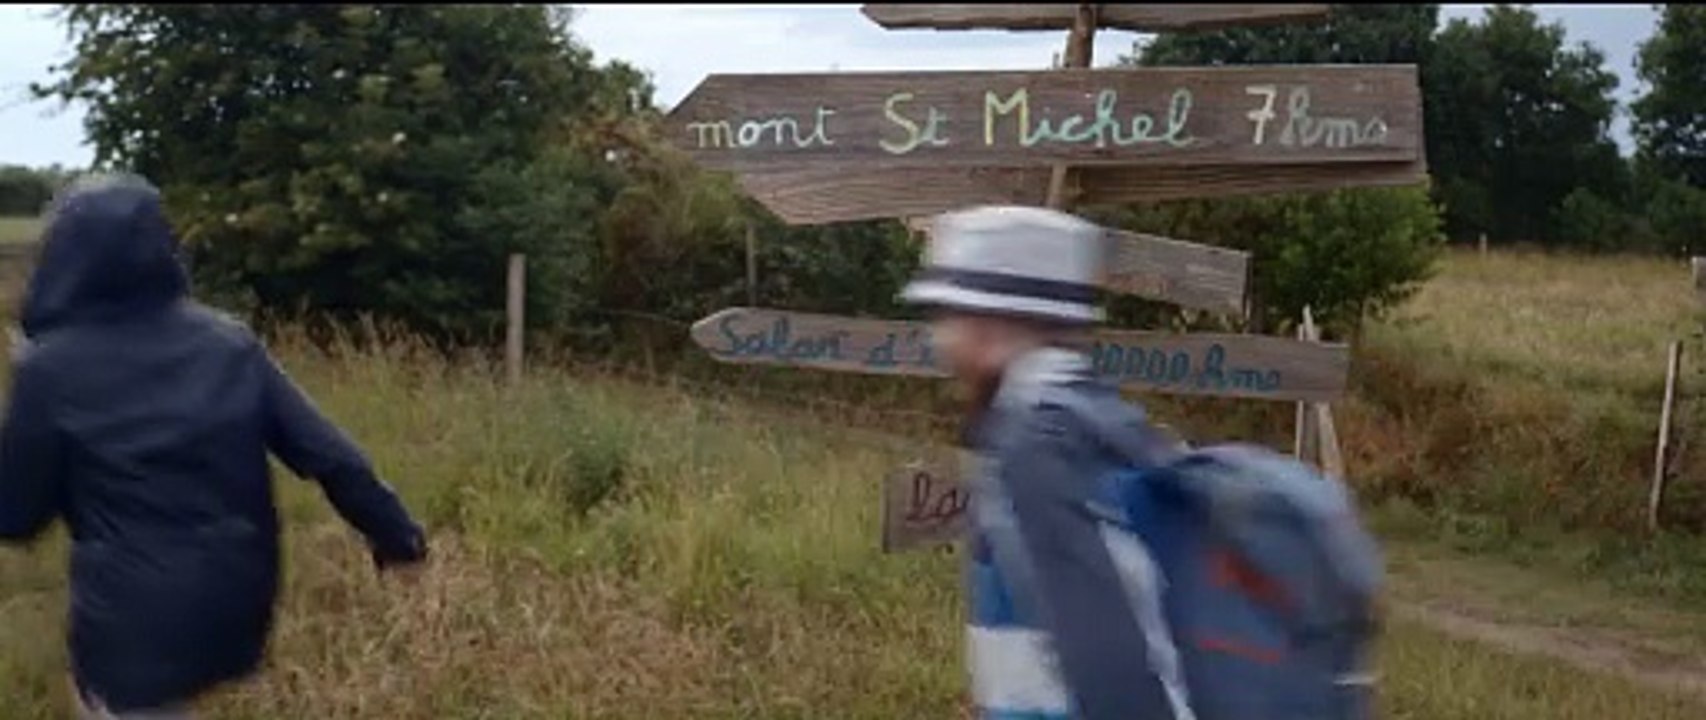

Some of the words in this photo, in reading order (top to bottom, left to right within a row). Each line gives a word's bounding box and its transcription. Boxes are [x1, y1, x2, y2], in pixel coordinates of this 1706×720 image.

[686, 105, 836, 148] mont
[878, 92, 949, 154] St
[983, 87, 1197, 147] Michel
